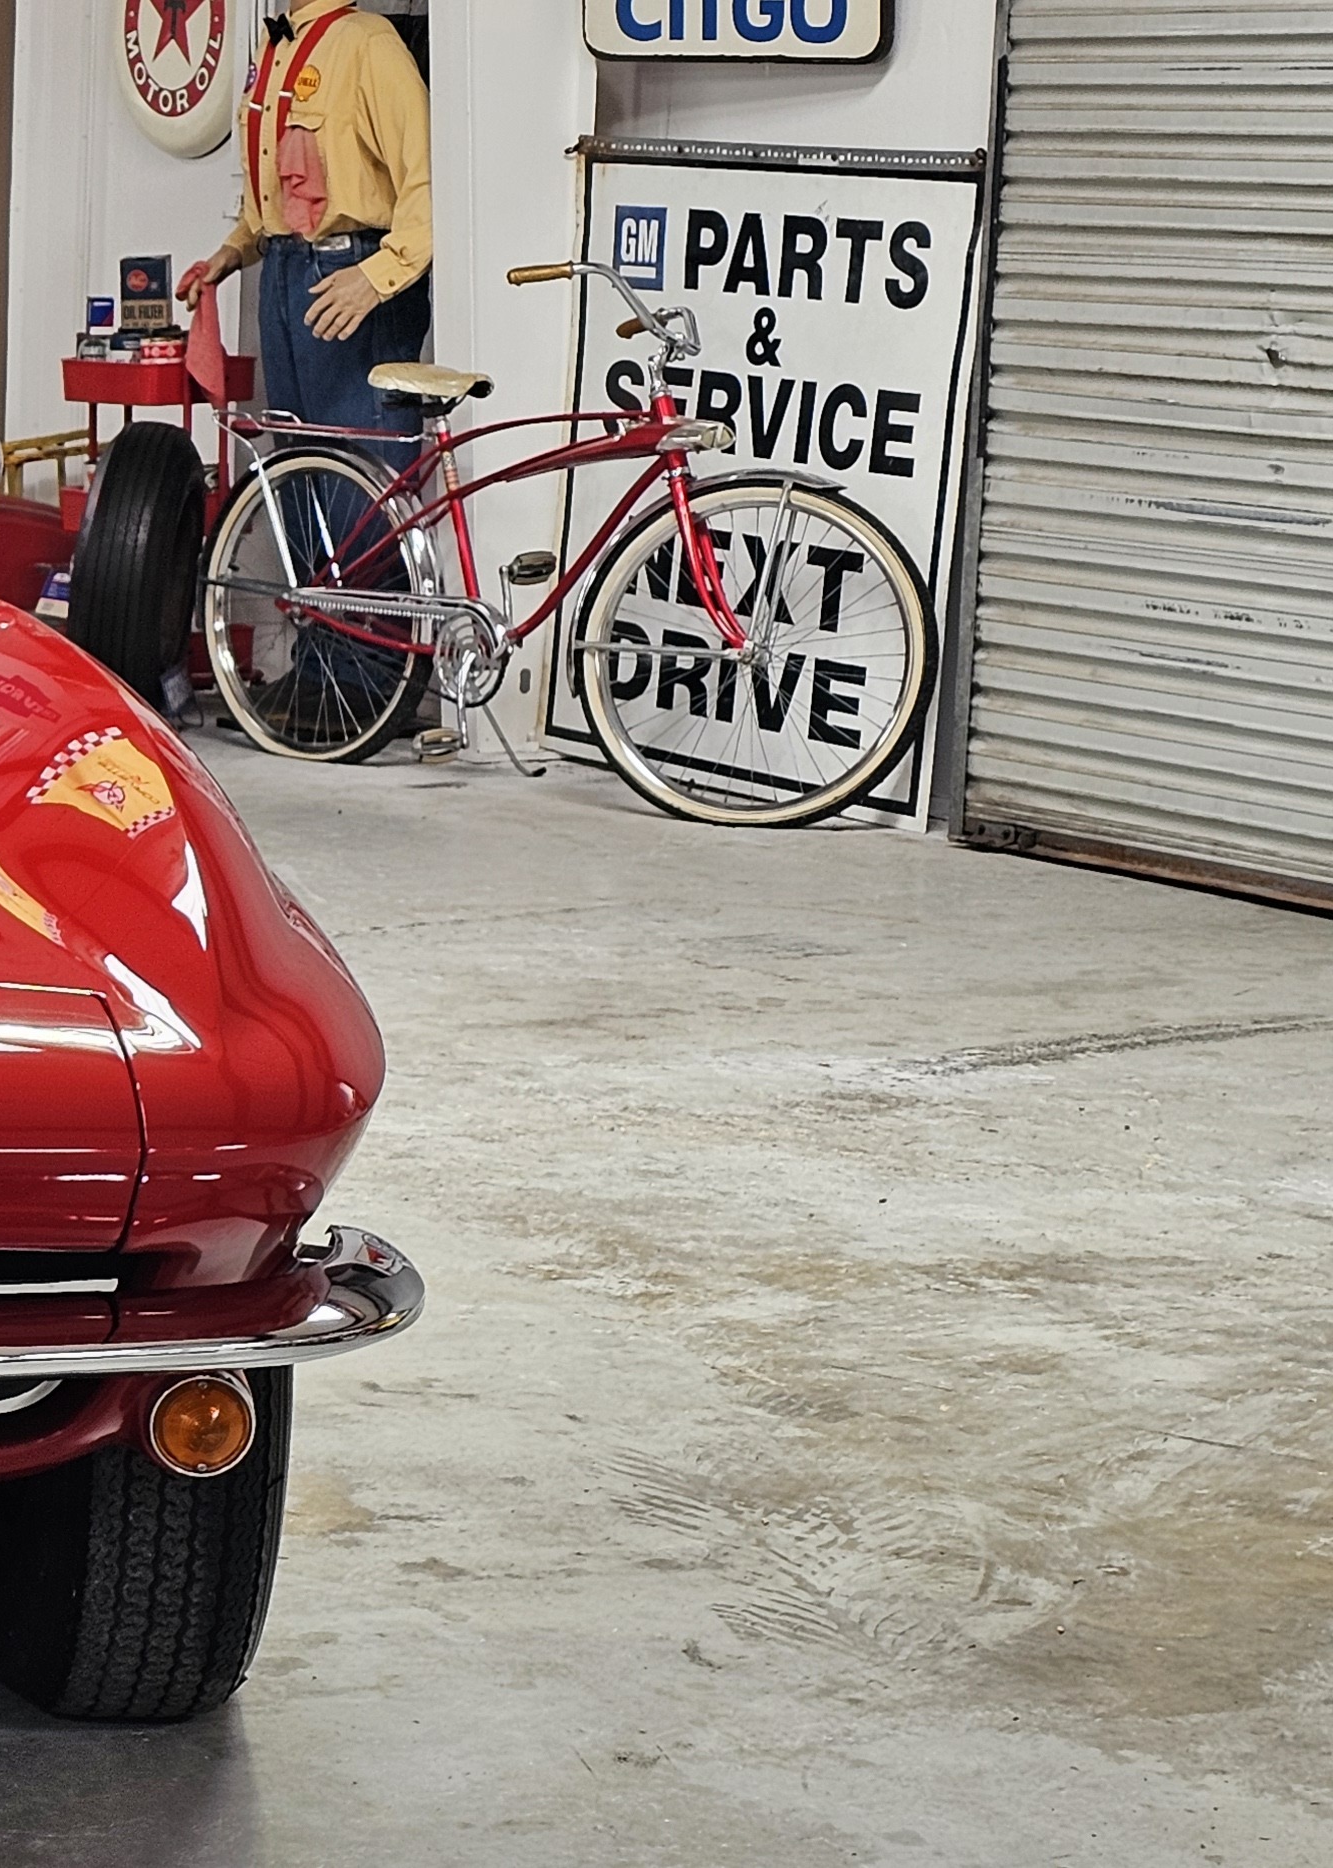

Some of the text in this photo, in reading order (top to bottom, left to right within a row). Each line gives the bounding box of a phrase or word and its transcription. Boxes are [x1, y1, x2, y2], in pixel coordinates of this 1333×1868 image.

[126, 30, 222, 113] MOTOR OIL
[621, 208, 931, 309] GM PARTS
[746, 307, 782, 367] &
[625, 528, 864, 633] NEXT
[609, 620, 866, 750] DRIVE
